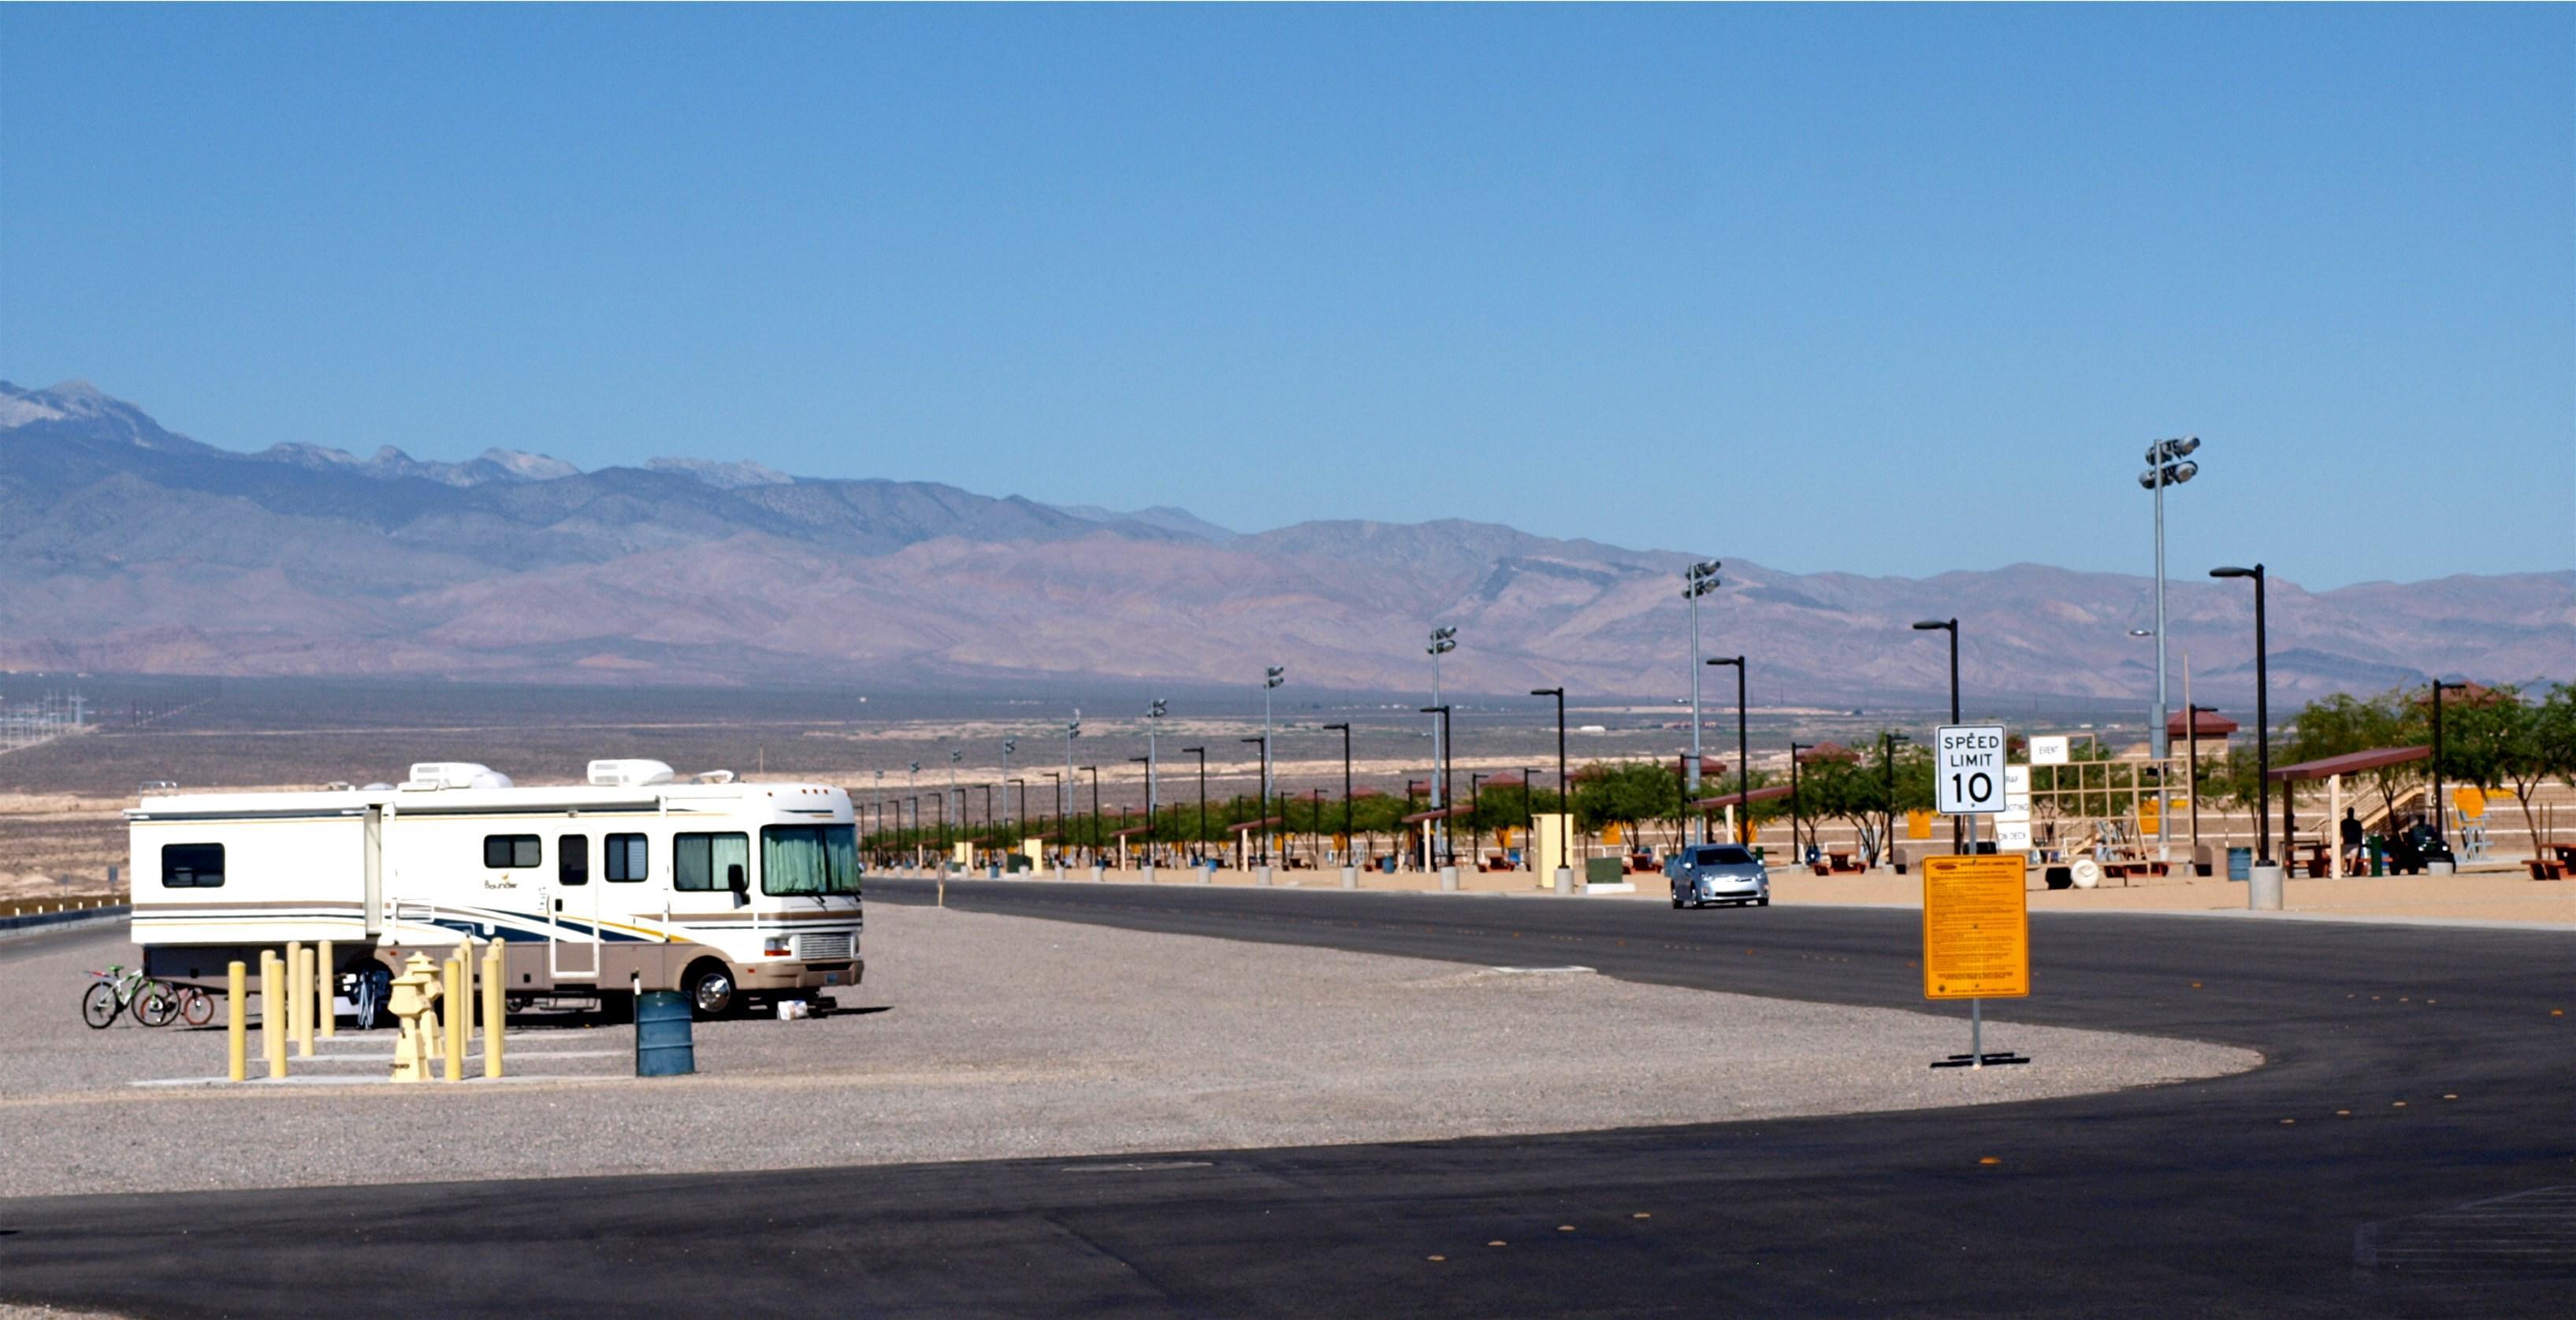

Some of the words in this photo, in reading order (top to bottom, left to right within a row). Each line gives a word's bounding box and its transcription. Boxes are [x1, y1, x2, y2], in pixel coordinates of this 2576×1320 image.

[1944, 736, 1999, 749] SPEED
[2039, 746, 2058, 755] EVENT
[1950, 753, 1992, 767] LIMIT
[1953, 772, 1992, 802] 10
